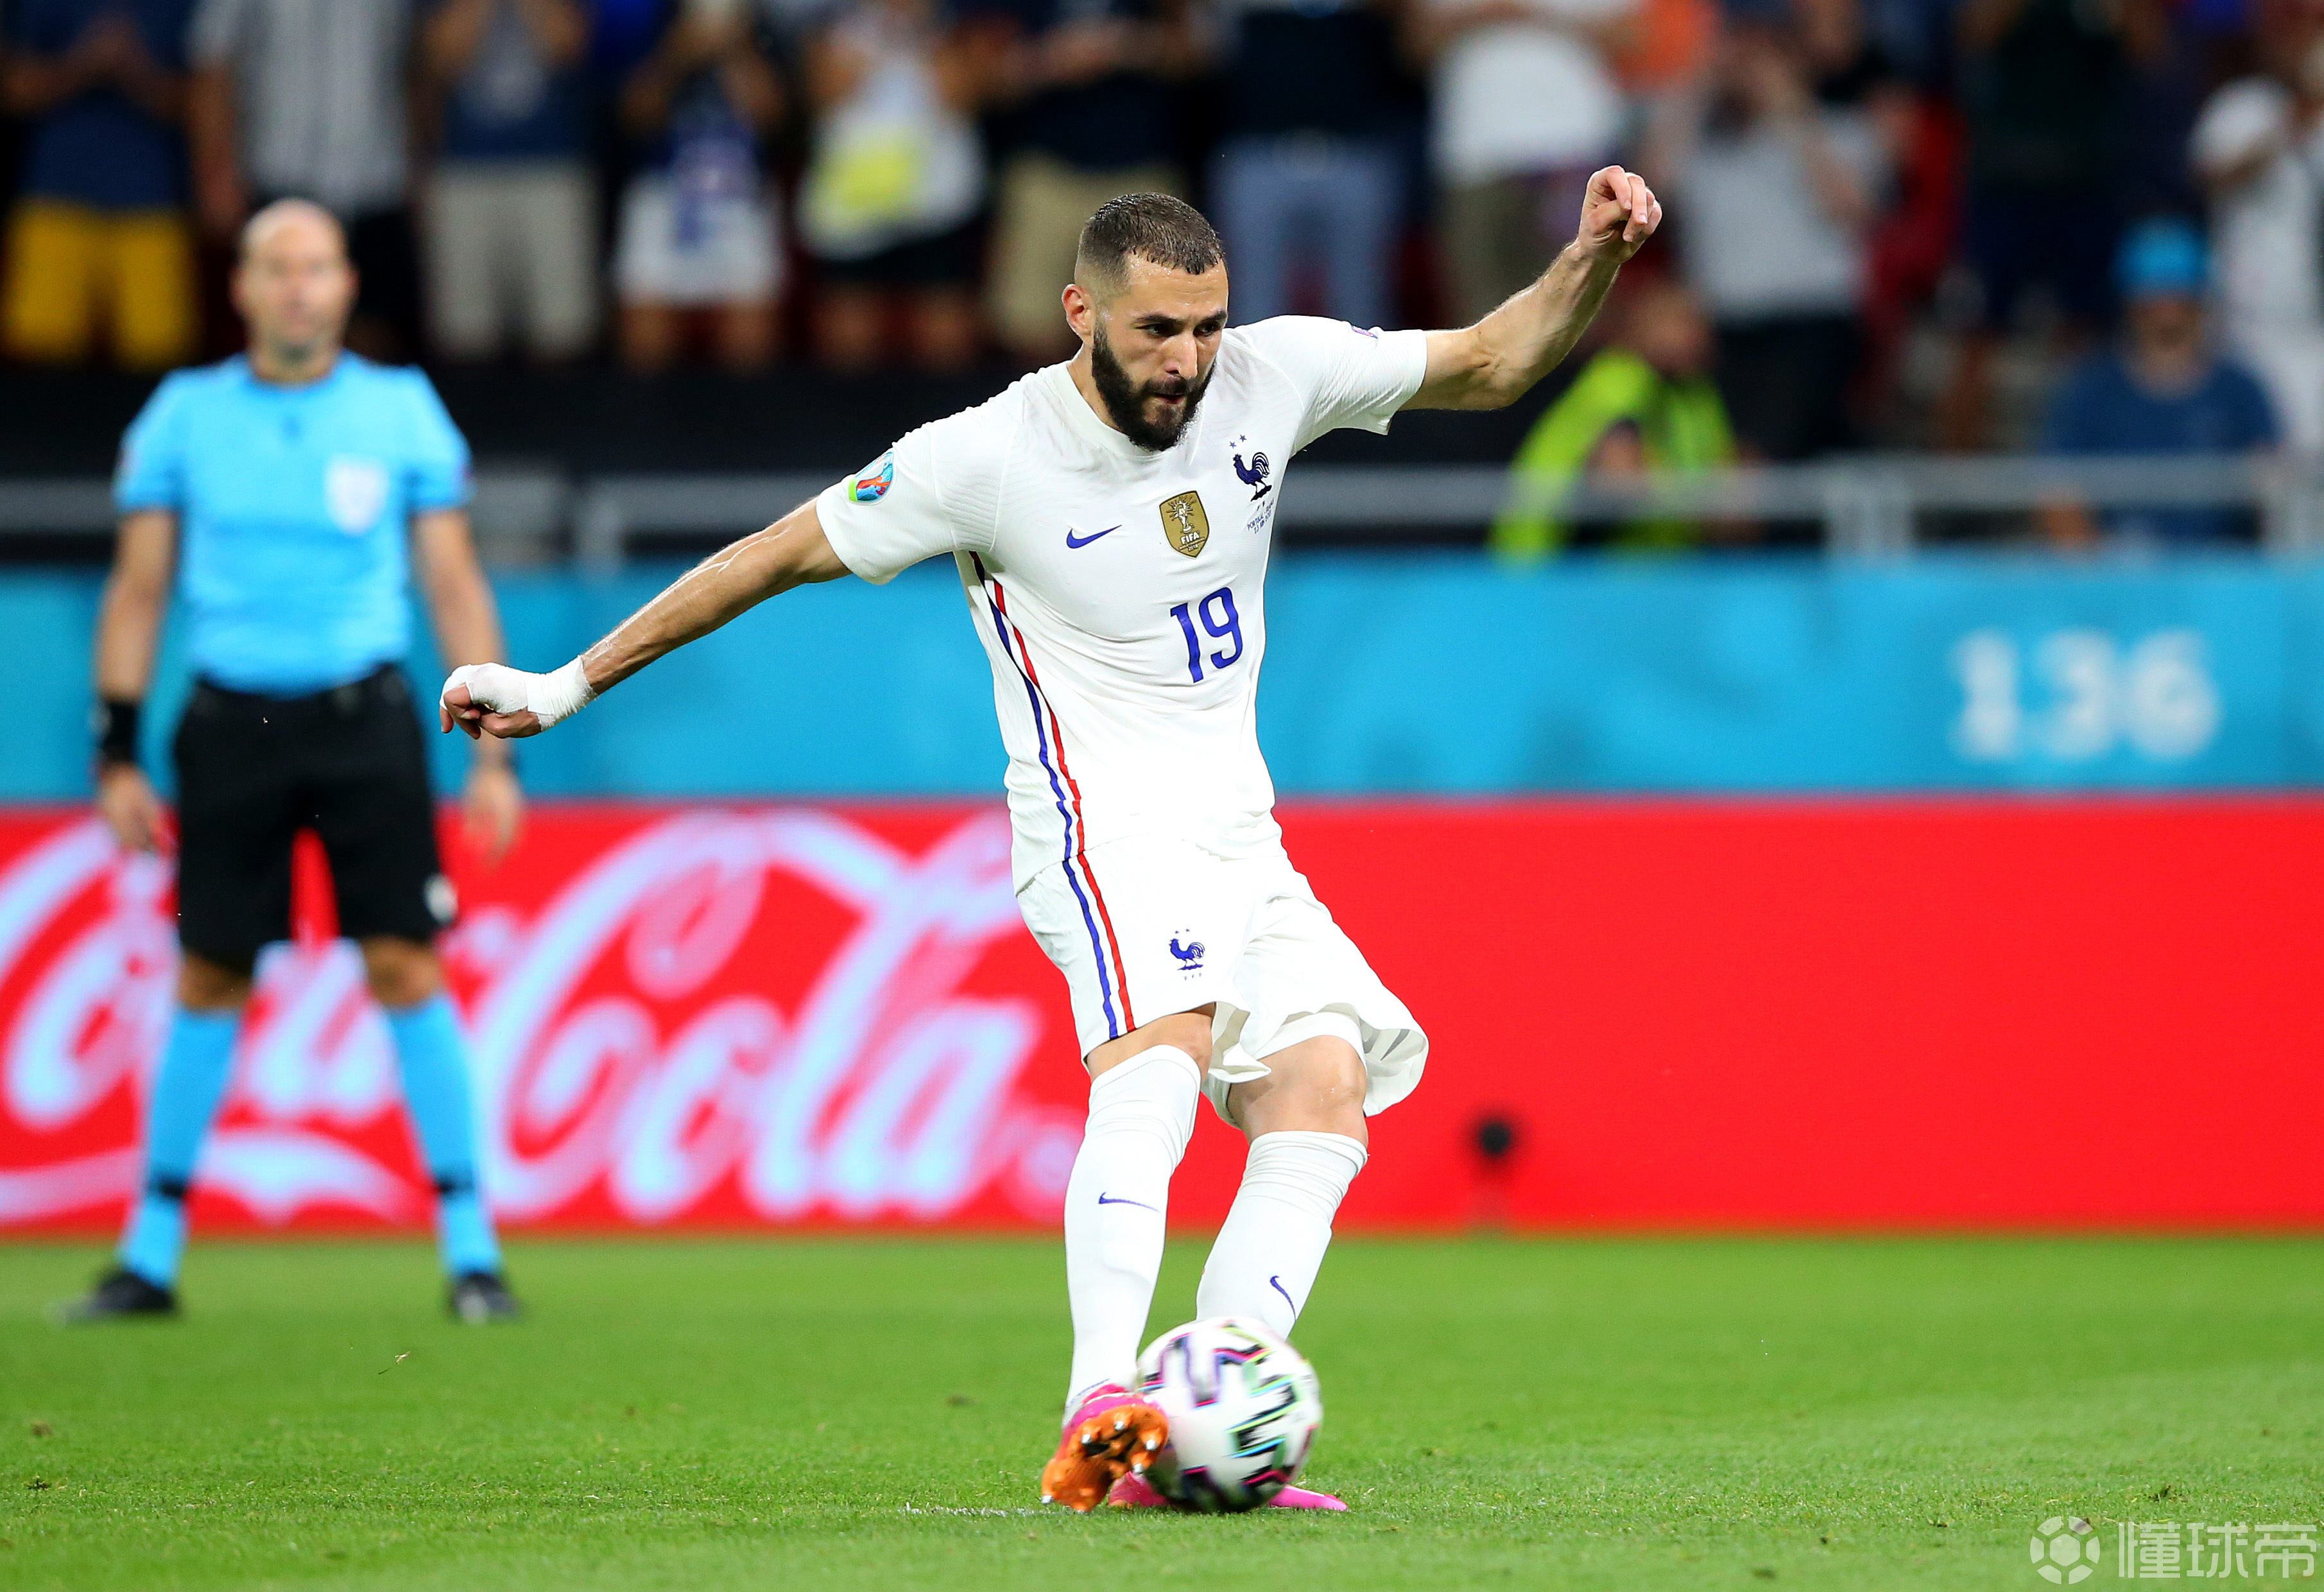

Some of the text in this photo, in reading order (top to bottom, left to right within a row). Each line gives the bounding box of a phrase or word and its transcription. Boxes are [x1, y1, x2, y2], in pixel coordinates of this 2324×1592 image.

[1181, 532, 1200, 544] FIFA
[1170, 587, 1243, 683] 19
[1950, 627, 2221, 760] 136
[0, 808, 1046, 1222] oa-Cola
